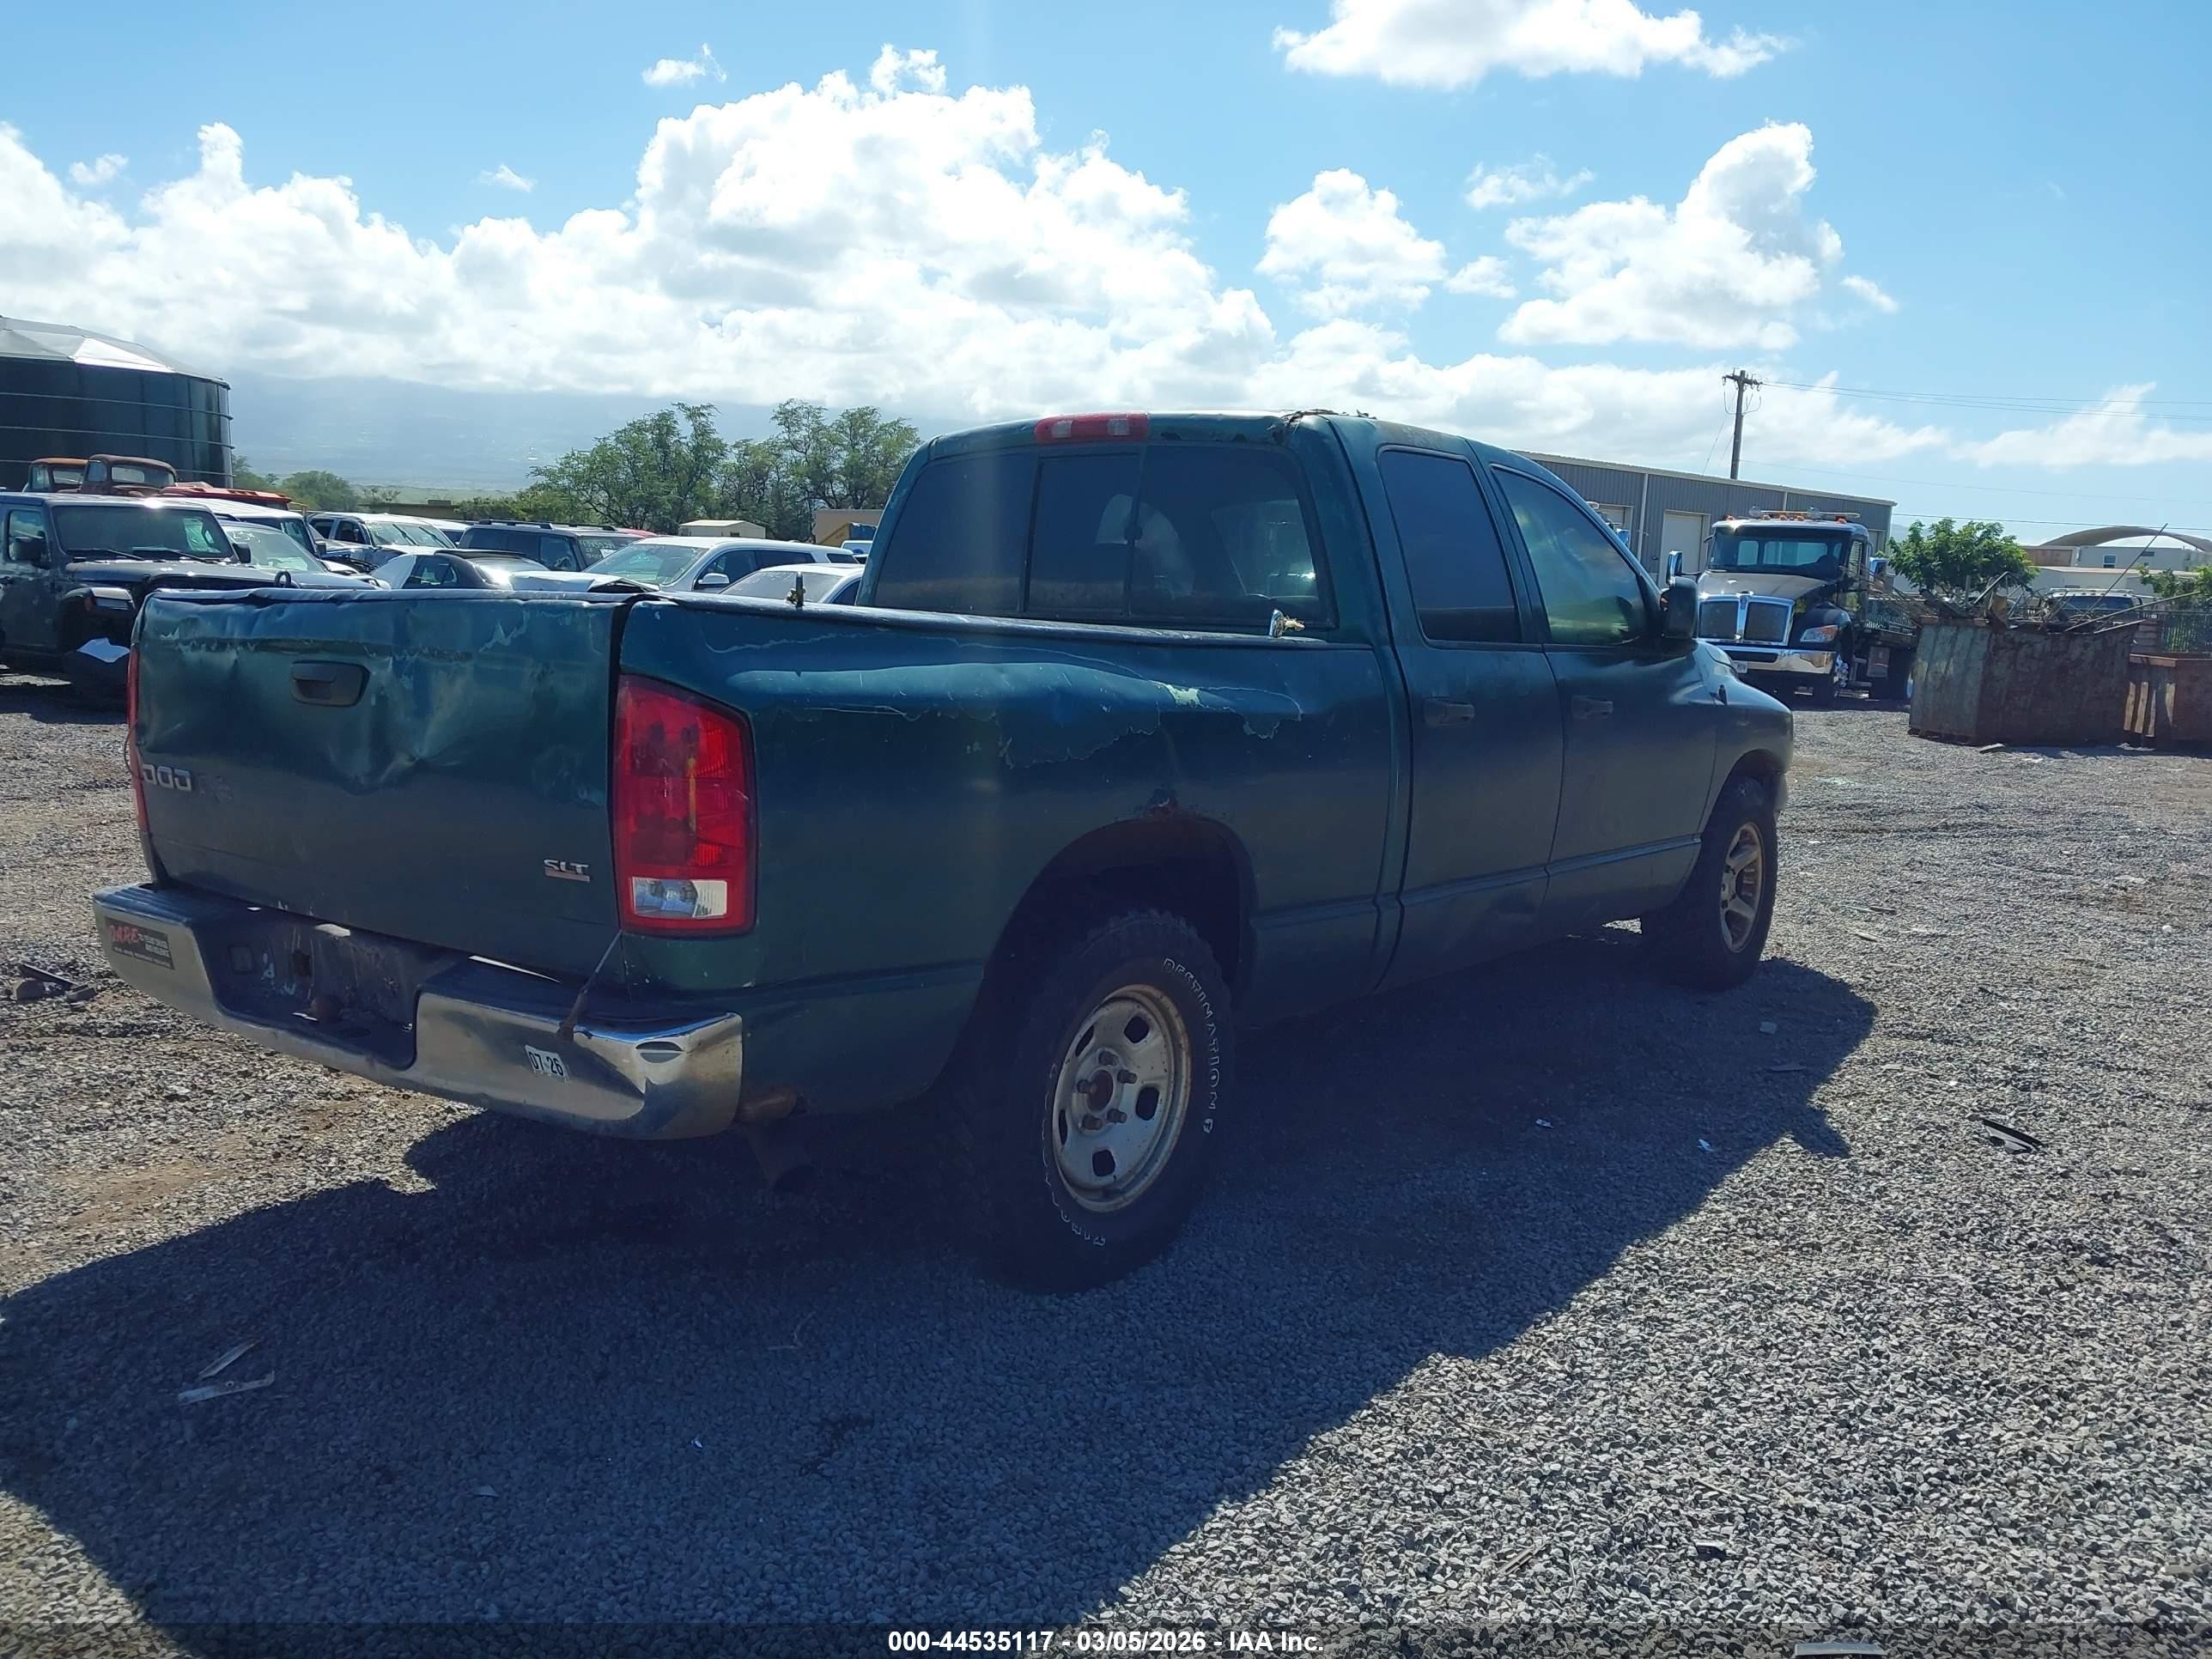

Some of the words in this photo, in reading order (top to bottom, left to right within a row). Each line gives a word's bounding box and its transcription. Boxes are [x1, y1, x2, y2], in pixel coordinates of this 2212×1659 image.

[543, 858, 591, 875] SLT
[528, 1051, 544, 1071] 07
[546, 1055, 564, 1076] 26
